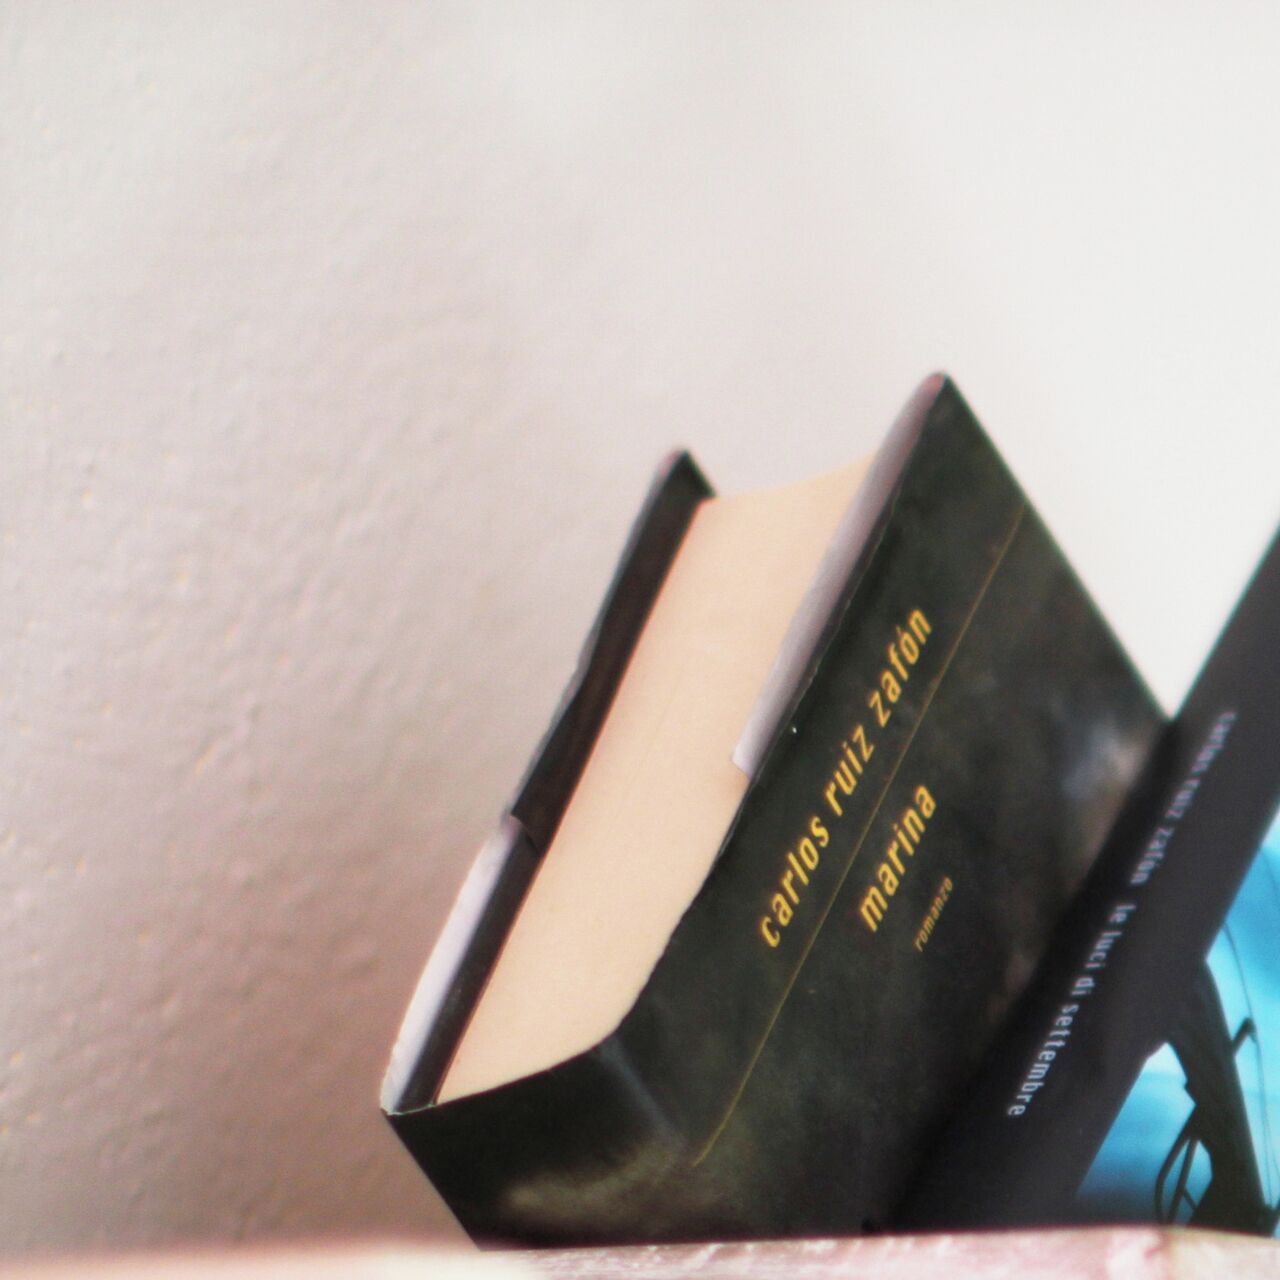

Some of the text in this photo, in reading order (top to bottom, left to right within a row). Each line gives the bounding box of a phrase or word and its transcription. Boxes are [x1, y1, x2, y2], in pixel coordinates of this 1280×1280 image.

[759, 608, 932, 948] carlos ruiz zafón
[858, 784, 937, 933] marina
[913, 876, 954, 953] romanzo
[1007, 1003, 1079, 1118] settembre
